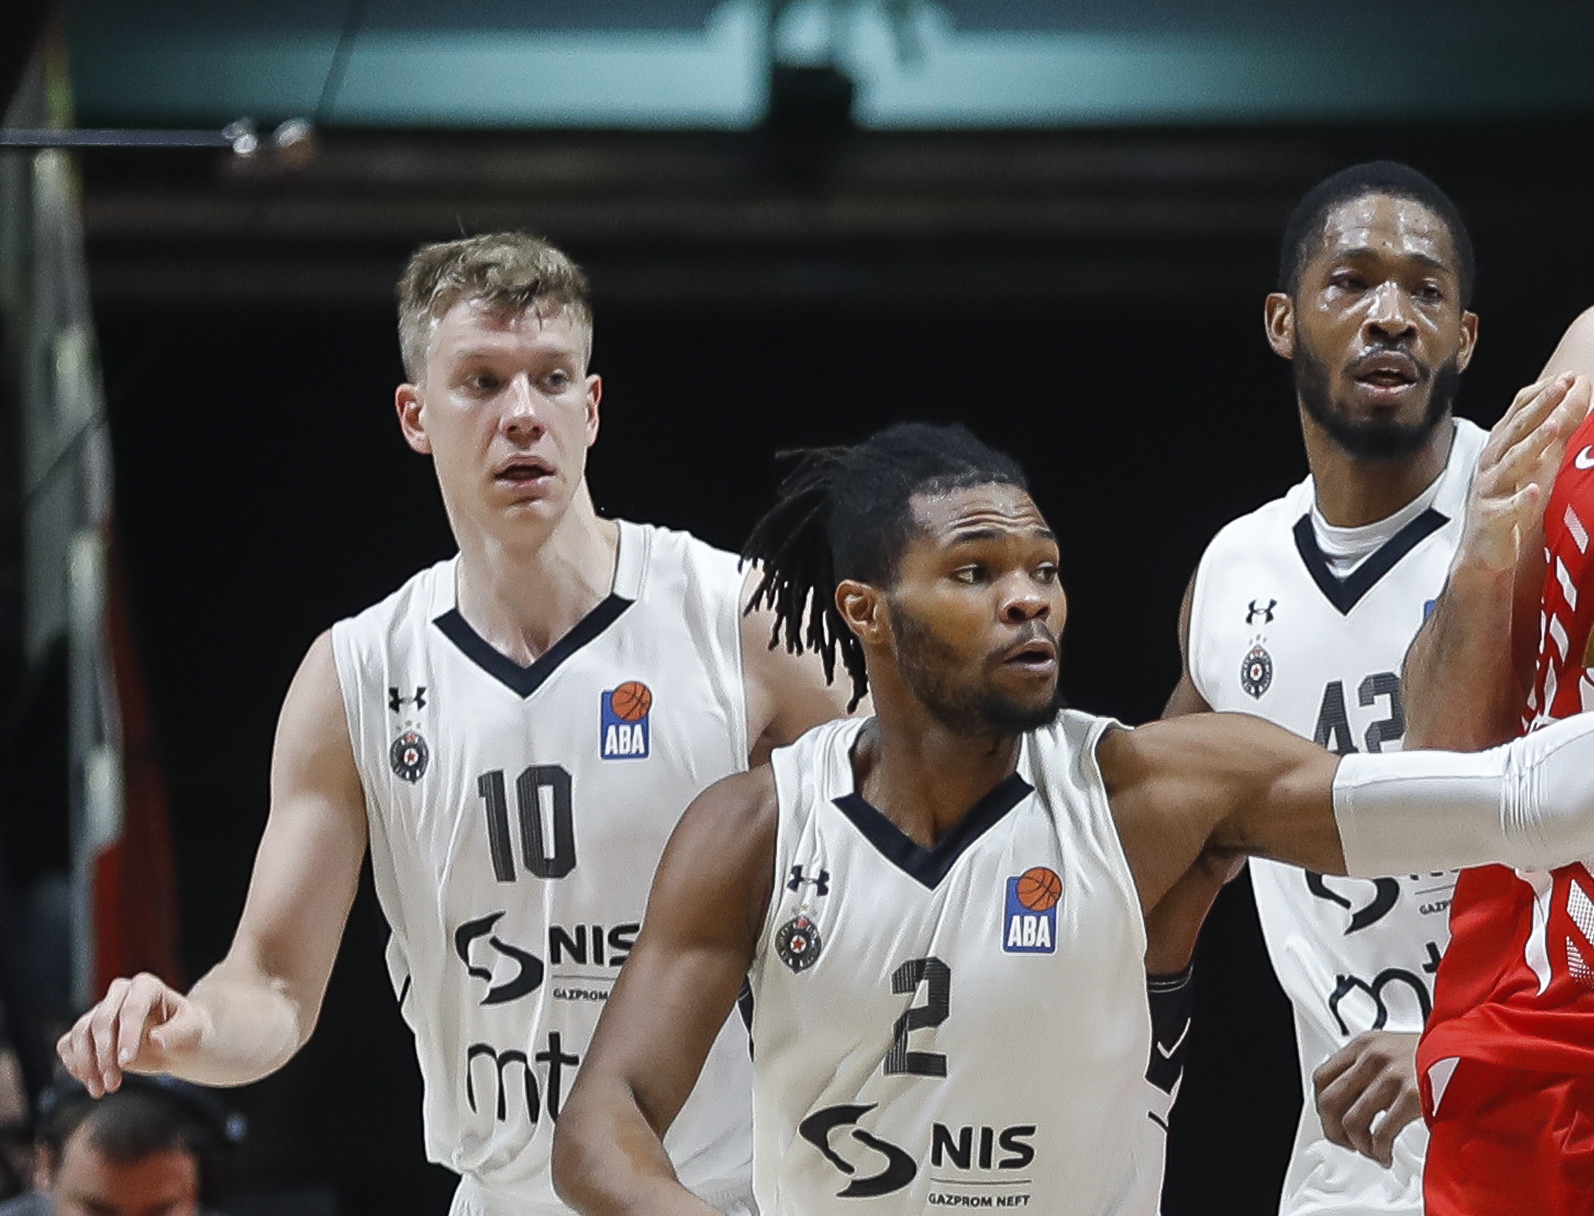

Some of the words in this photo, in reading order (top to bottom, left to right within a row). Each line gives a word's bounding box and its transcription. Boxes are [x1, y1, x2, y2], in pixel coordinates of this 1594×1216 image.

[604, 724, 646, 756] ABA
[477, 764, 577, 883] 10
[549, 923, 641, 967] NIS
[1006, 914, 1052, 949] ABA
[883, 956, 951, 1078] 2
[466, 1030, 580, 1124] mt
[931, 1122, 1036, 1171] NIS
[928, 1192, 993, 1208] GAZPROM
[996, 1194, 1031, 1207] NEFT
